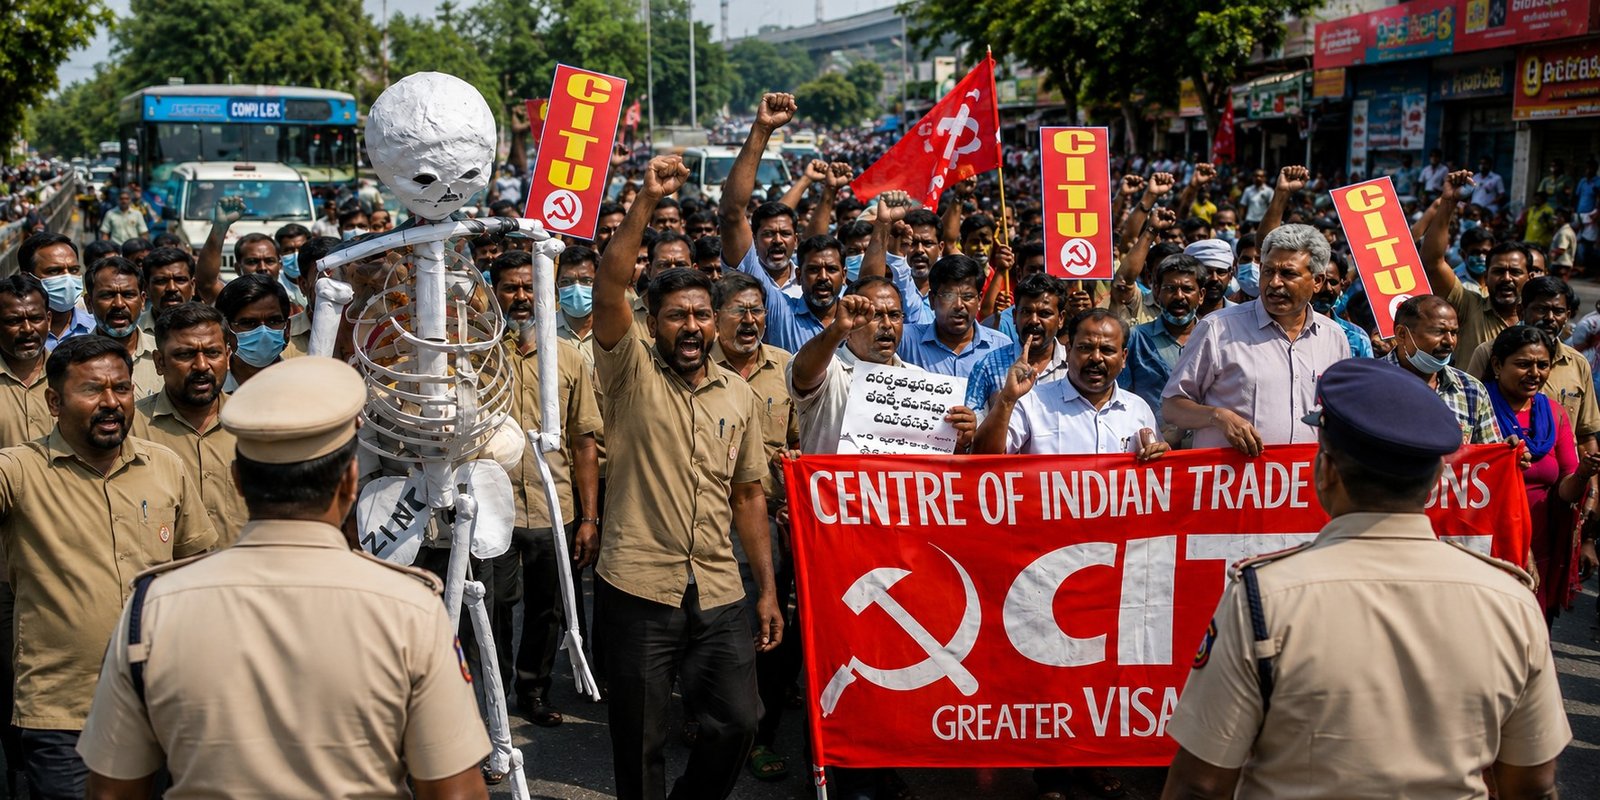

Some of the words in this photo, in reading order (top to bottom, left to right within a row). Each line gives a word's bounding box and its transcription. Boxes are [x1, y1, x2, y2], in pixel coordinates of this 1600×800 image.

[548, 73, 612, 192] CITU
[1053, 130, 1099, 238] CITU
[1345, 184, 1417, 295] CITU
[810, 470, 967, 526] CENTRE
[977, 471, 1024, 526] OF
[1039, 466, 1172, 520] INDIAN
[1187, 461, 1311, 511] TRADE
[1002, 533, 1493, 667] CIT
[931, 703, 1076, 741] GREATER
